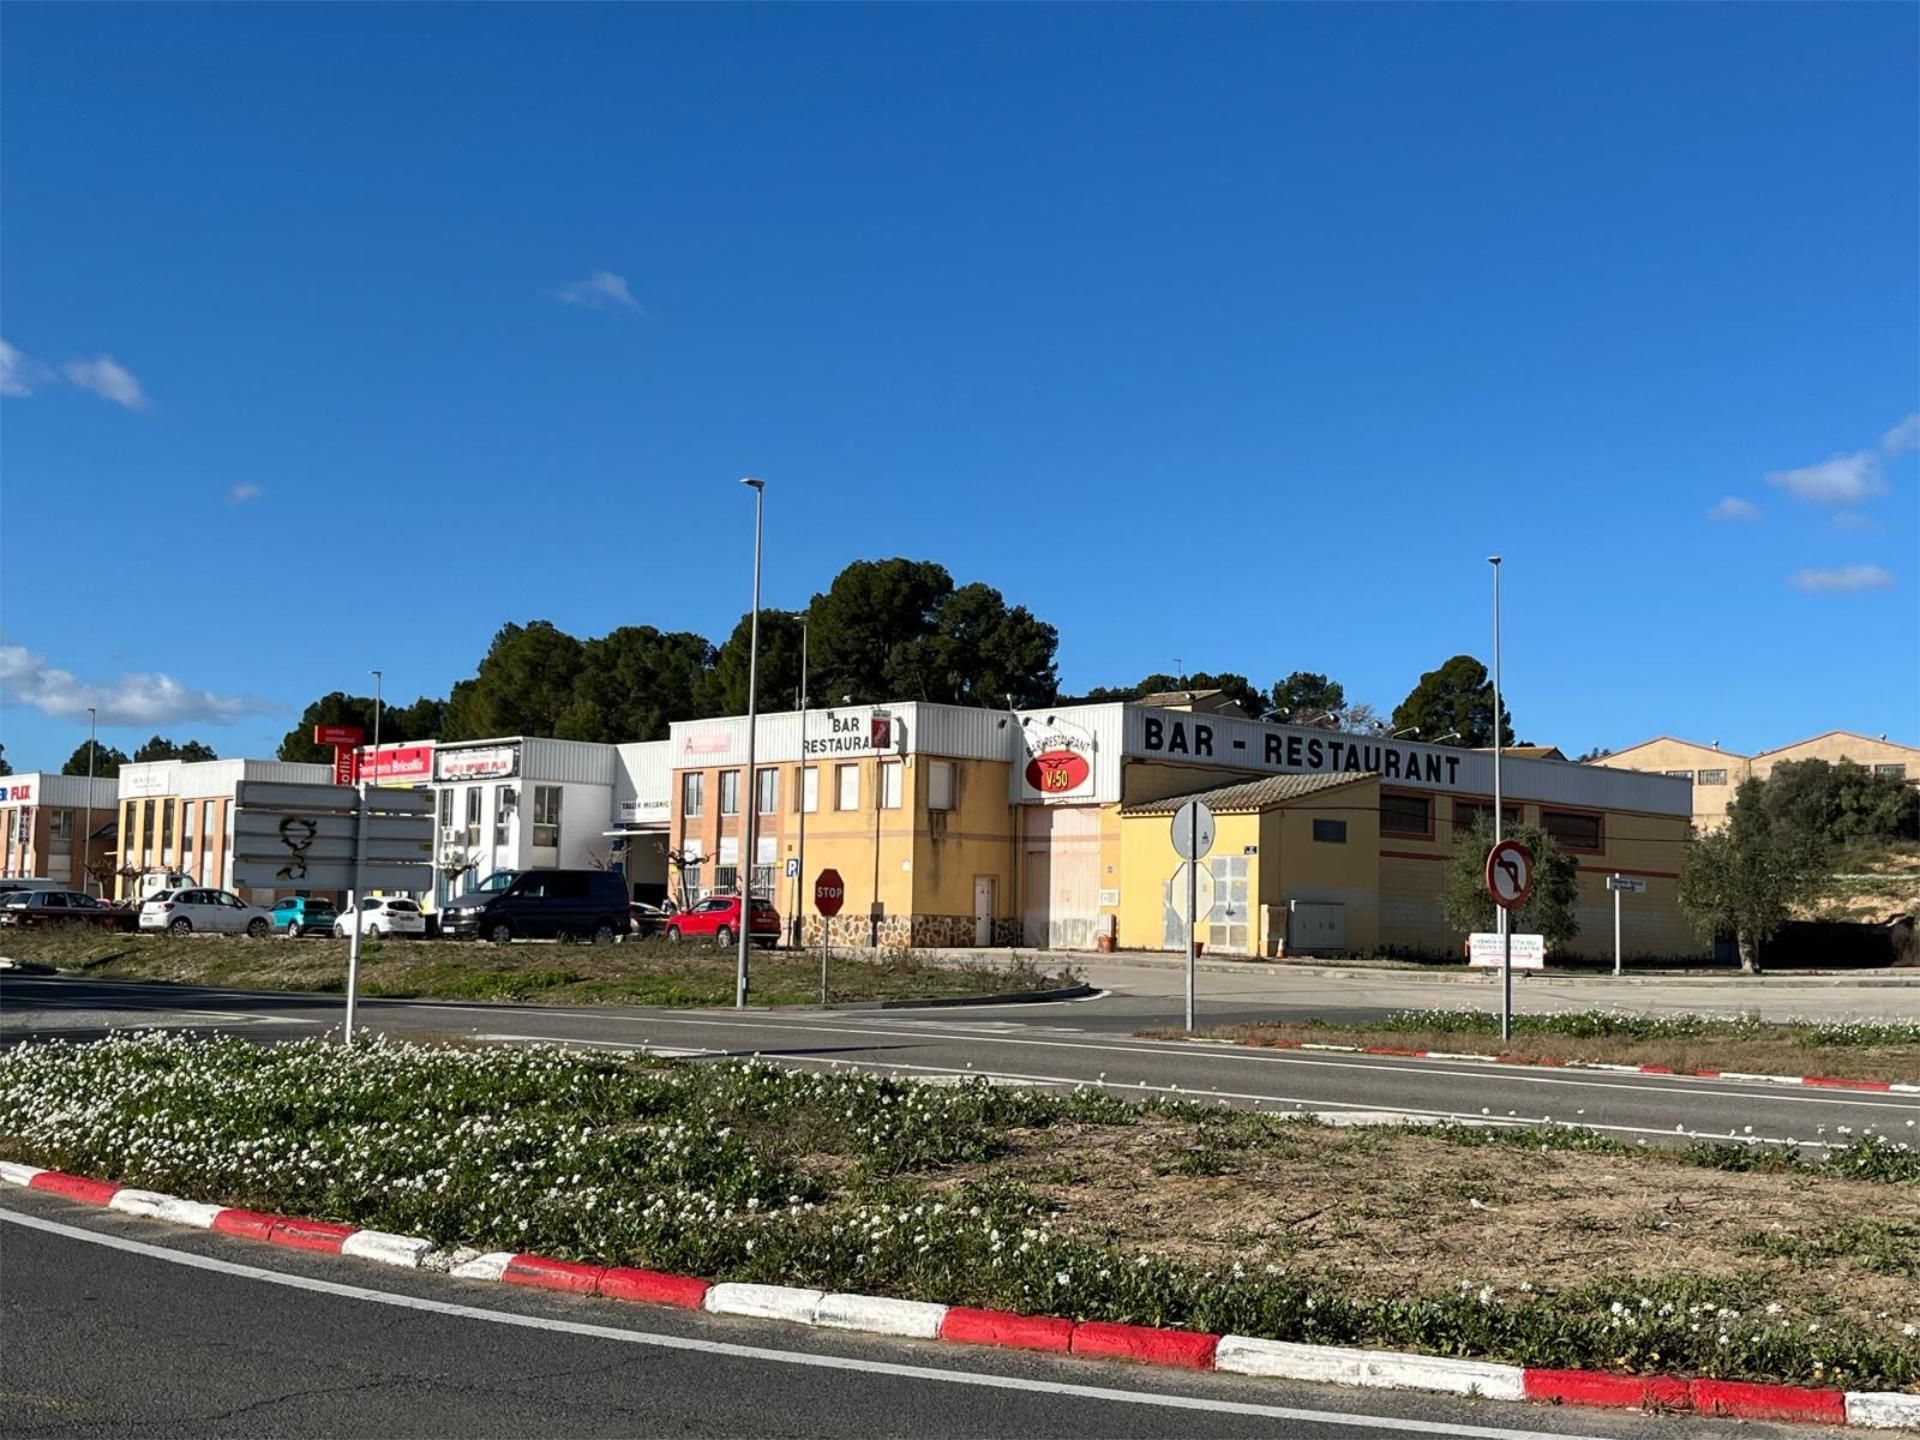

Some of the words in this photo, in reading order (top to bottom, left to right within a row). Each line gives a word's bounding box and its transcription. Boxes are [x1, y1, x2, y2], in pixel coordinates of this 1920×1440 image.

[832, 717, 860, 733] BAR
[803, 736, 871, 754] RESTAURA
[1145, 717, 1213, 757] BAR
[1264, 733, 1460, 784] RESTAURANT
[340, 753, 351, 785] oflix
[11, 785, 31, 801] FLIX
[816, 886, 842, 898] STOP
